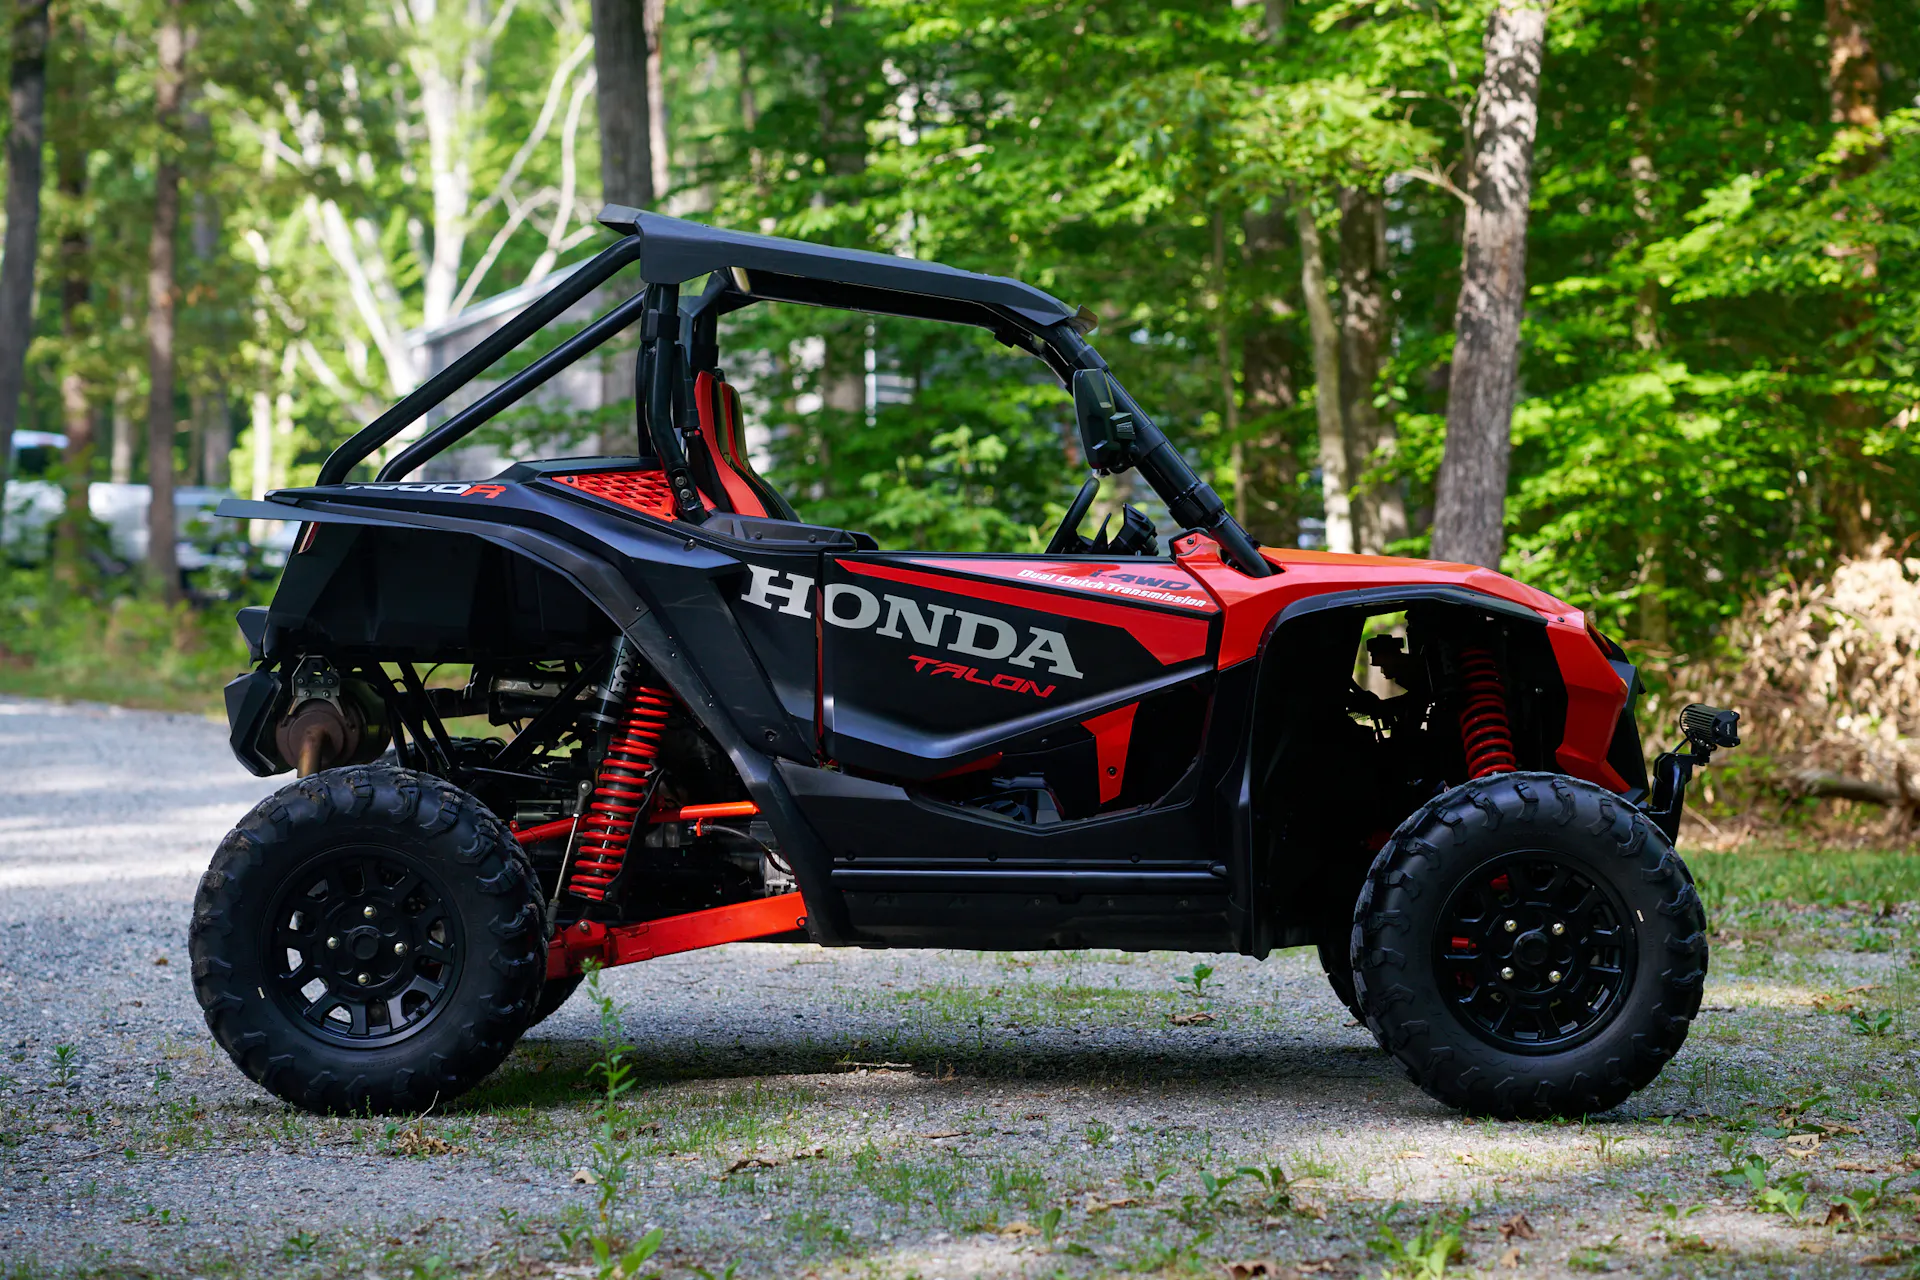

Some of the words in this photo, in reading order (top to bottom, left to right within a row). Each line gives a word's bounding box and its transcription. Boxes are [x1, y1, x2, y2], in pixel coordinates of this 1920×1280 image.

[1017, 569, 1053, 581] Dual
[1056, 576, 1106, 588] Clutch
[1102, 583, 1206, 607] Transmission
[1091, 570, 1190, 591] i-4WD
[741, 564, 1083, 679] HONDA
[908, 655, 1056, 698] TALON
